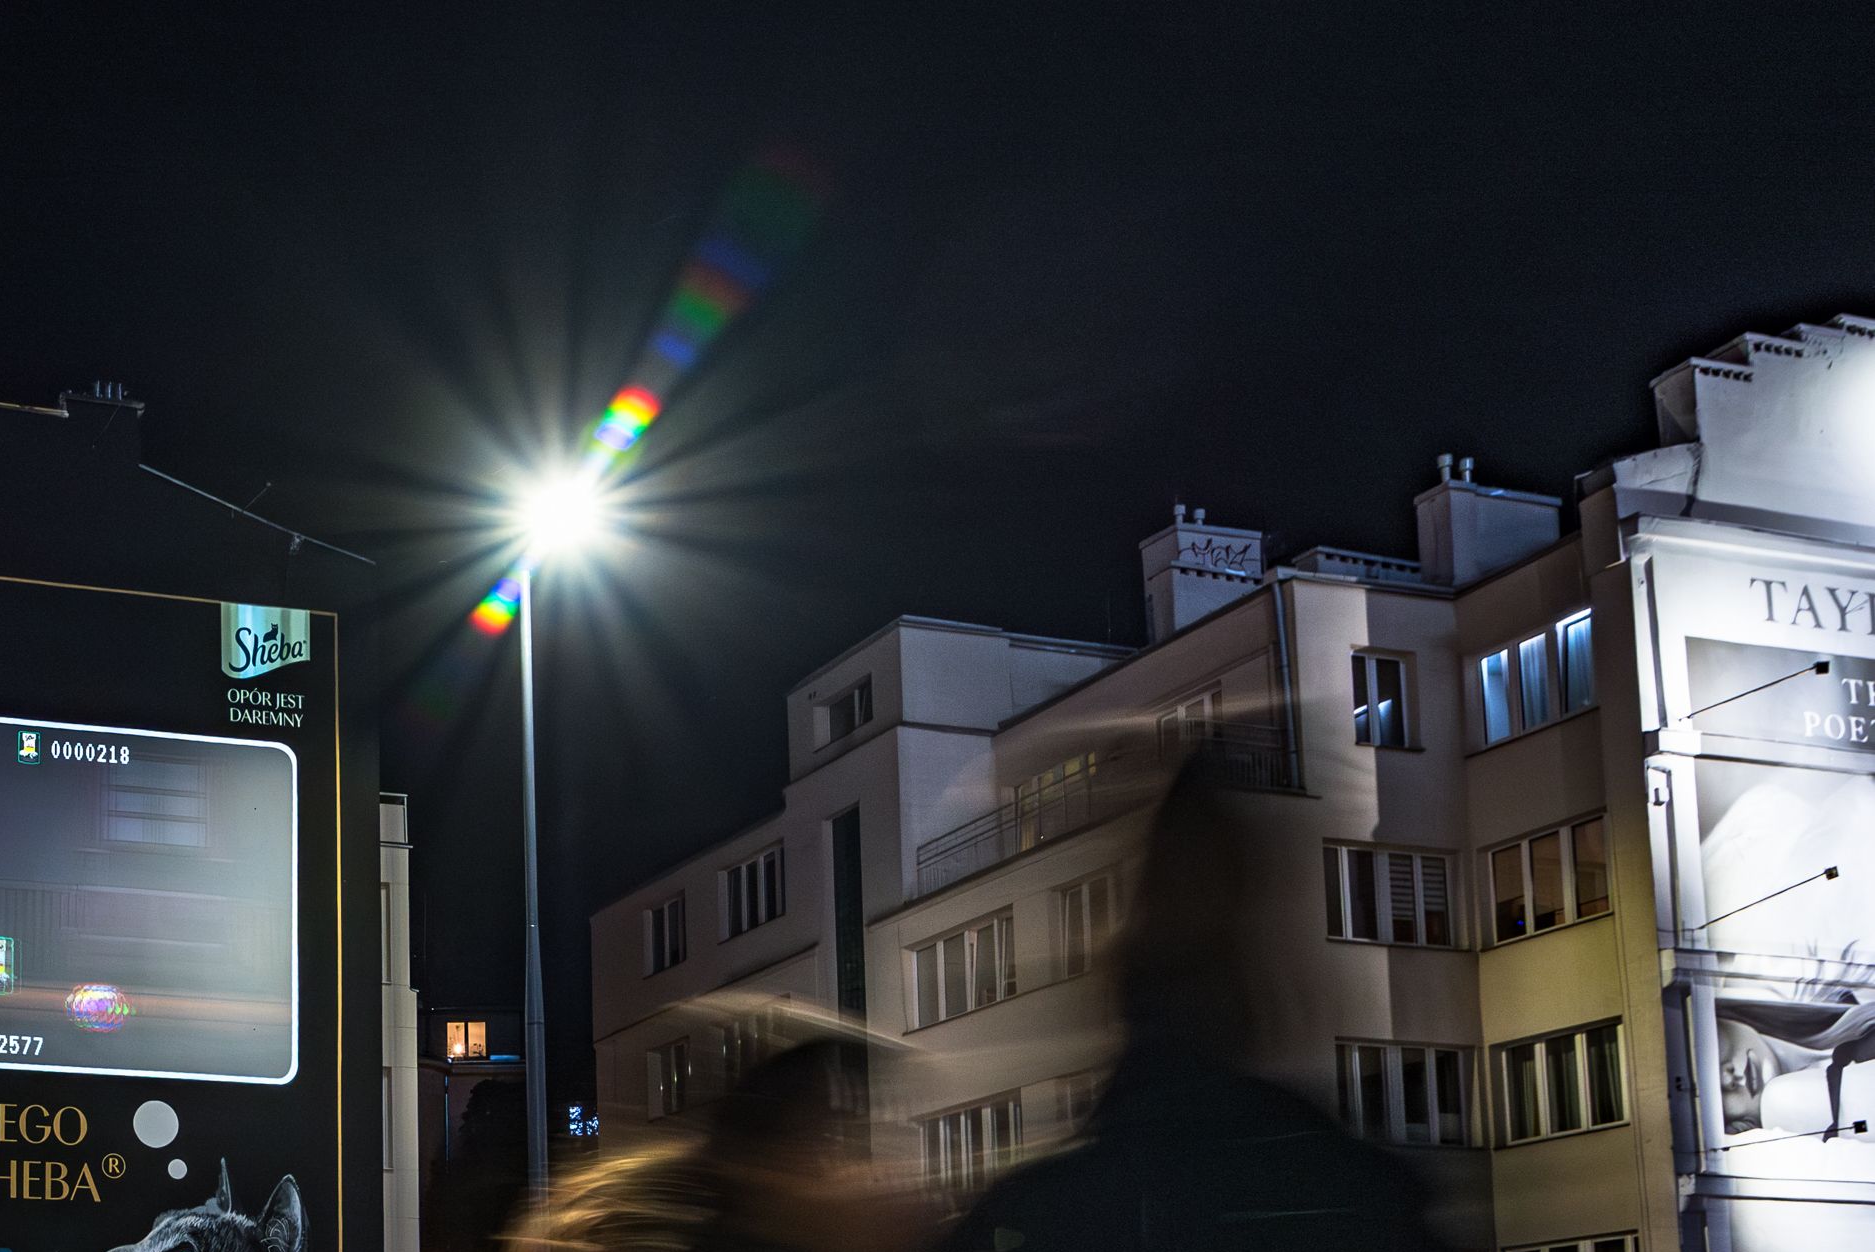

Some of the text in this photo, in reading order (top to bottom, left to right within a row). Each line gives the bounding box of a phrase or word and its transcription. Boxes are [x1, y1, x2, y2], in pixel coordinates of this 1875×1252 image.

[227, 688, 305, 710] OPÓR JEST
[229, 707, 304, 728] DAREMNY
[1803, 711, 1875, 743] POE
[51, 740, 130, 765] 0000218
